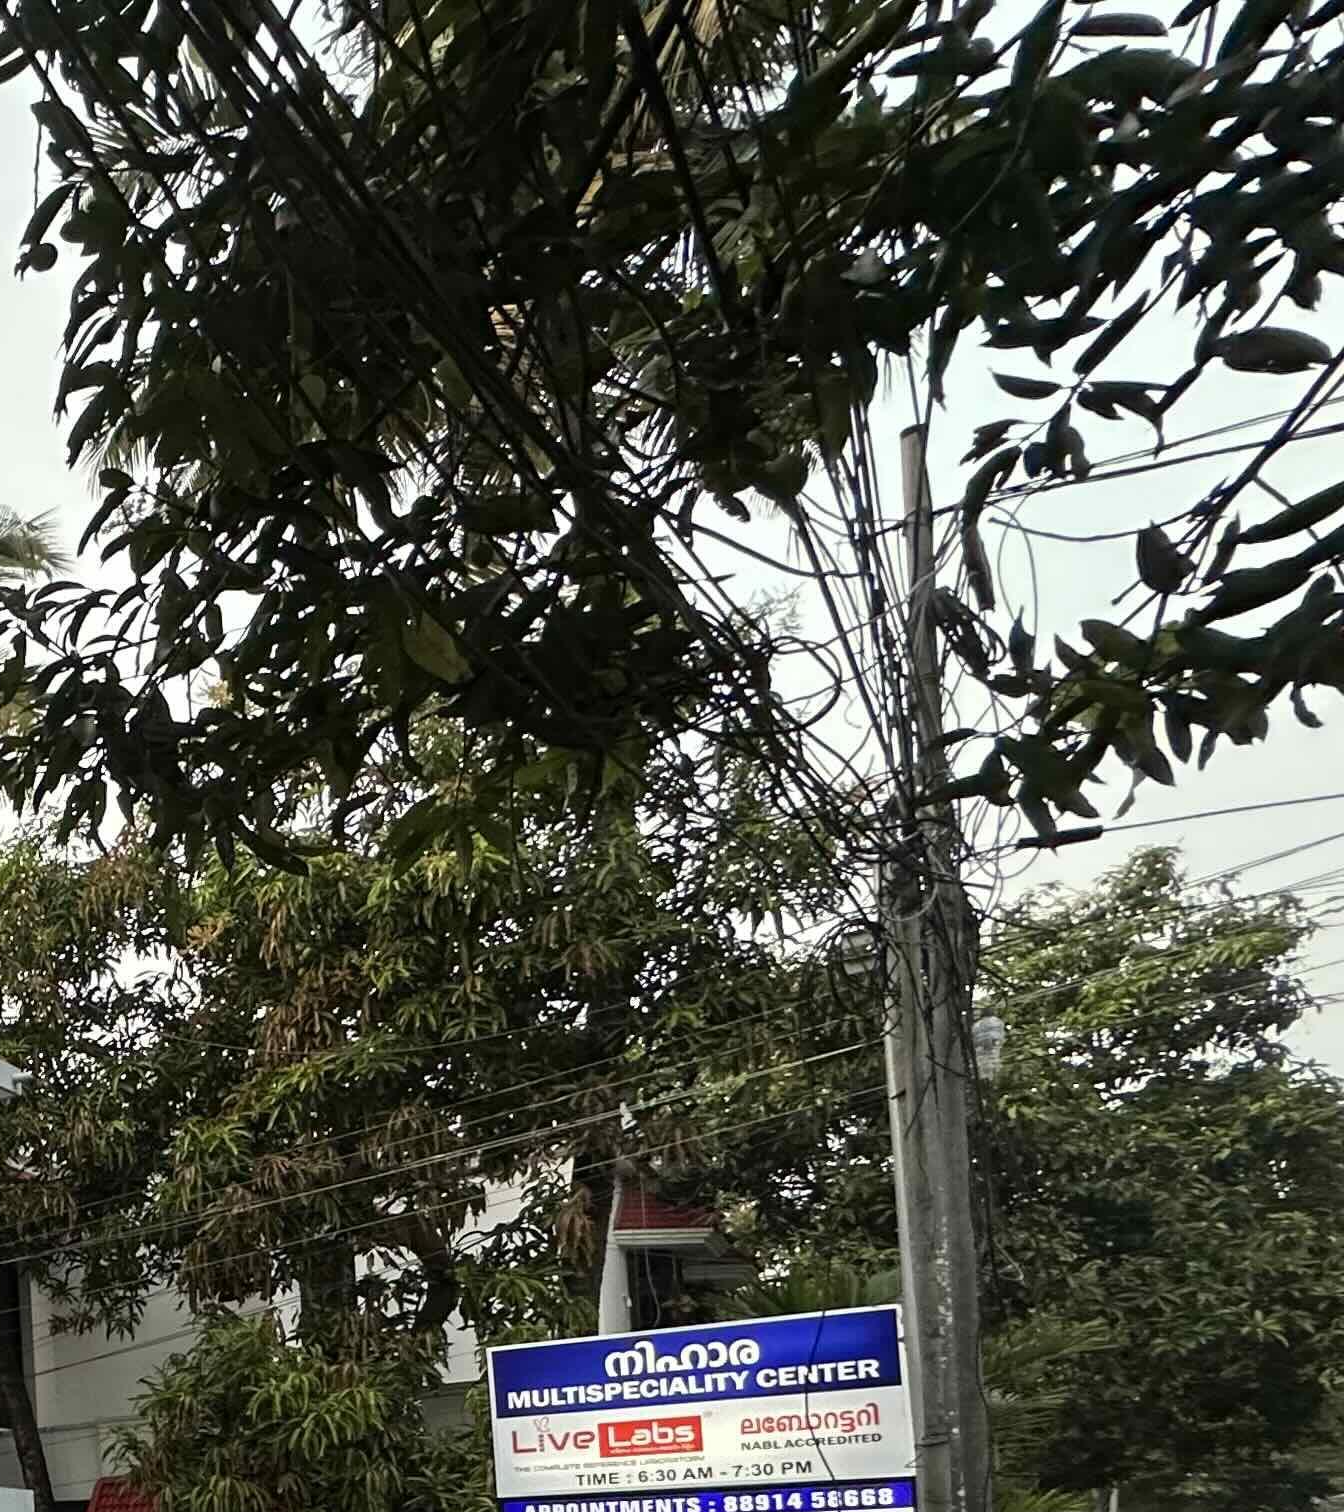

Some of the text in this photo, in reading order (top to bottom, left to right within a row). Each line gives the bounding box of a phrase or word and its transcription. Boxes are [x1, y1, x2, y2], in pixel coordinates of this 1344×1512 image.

[507, 1358, 880, 1410] MULTISPECIALITY CENTER
[607, 1421, 696, 1448] Labs
[741, 1433, 883, 1451] NABL ACCREDITED
[576, 1472, 620, 1487] TIME
[638, 1469, 677, 1483] 6:30
[682, 1466, 713, 1481] AM
[732, 1463, 774, 1478] 7:30
[781, 1460, 812, 1475] PM
[723, 1491, 803, 1512] 88914
[811, 1487, 894, 1509] 58668
